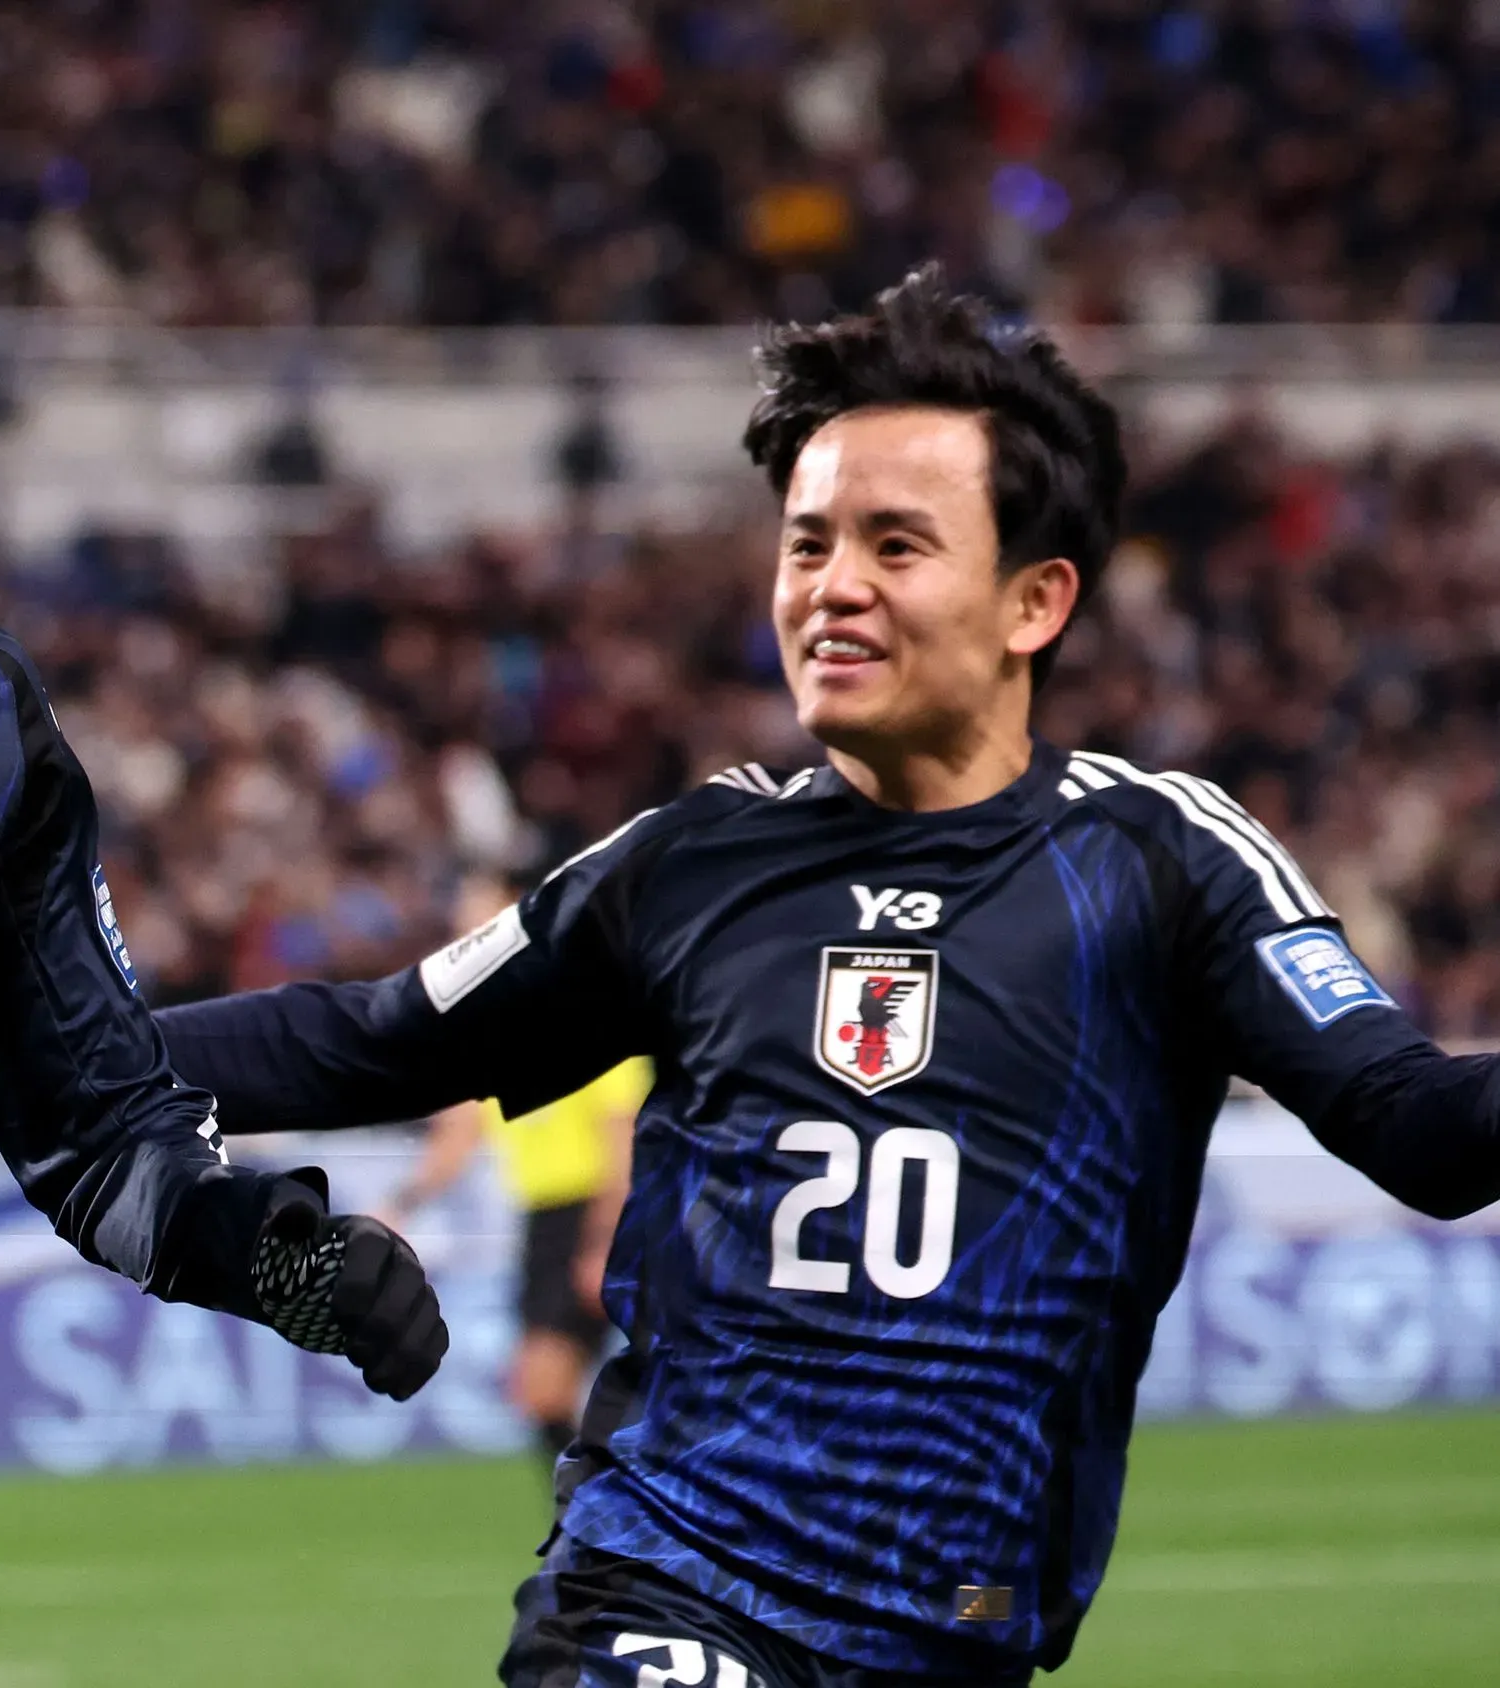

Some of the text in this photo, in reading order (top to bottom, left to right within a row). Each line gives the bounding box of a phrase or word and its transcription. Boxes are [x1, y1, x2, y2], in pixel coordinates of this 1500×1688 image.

[850, 884, 943, 931] Y-3
[850, 954, 912, 969] JAPAN
[767, 1120, 961, 1300] 20
